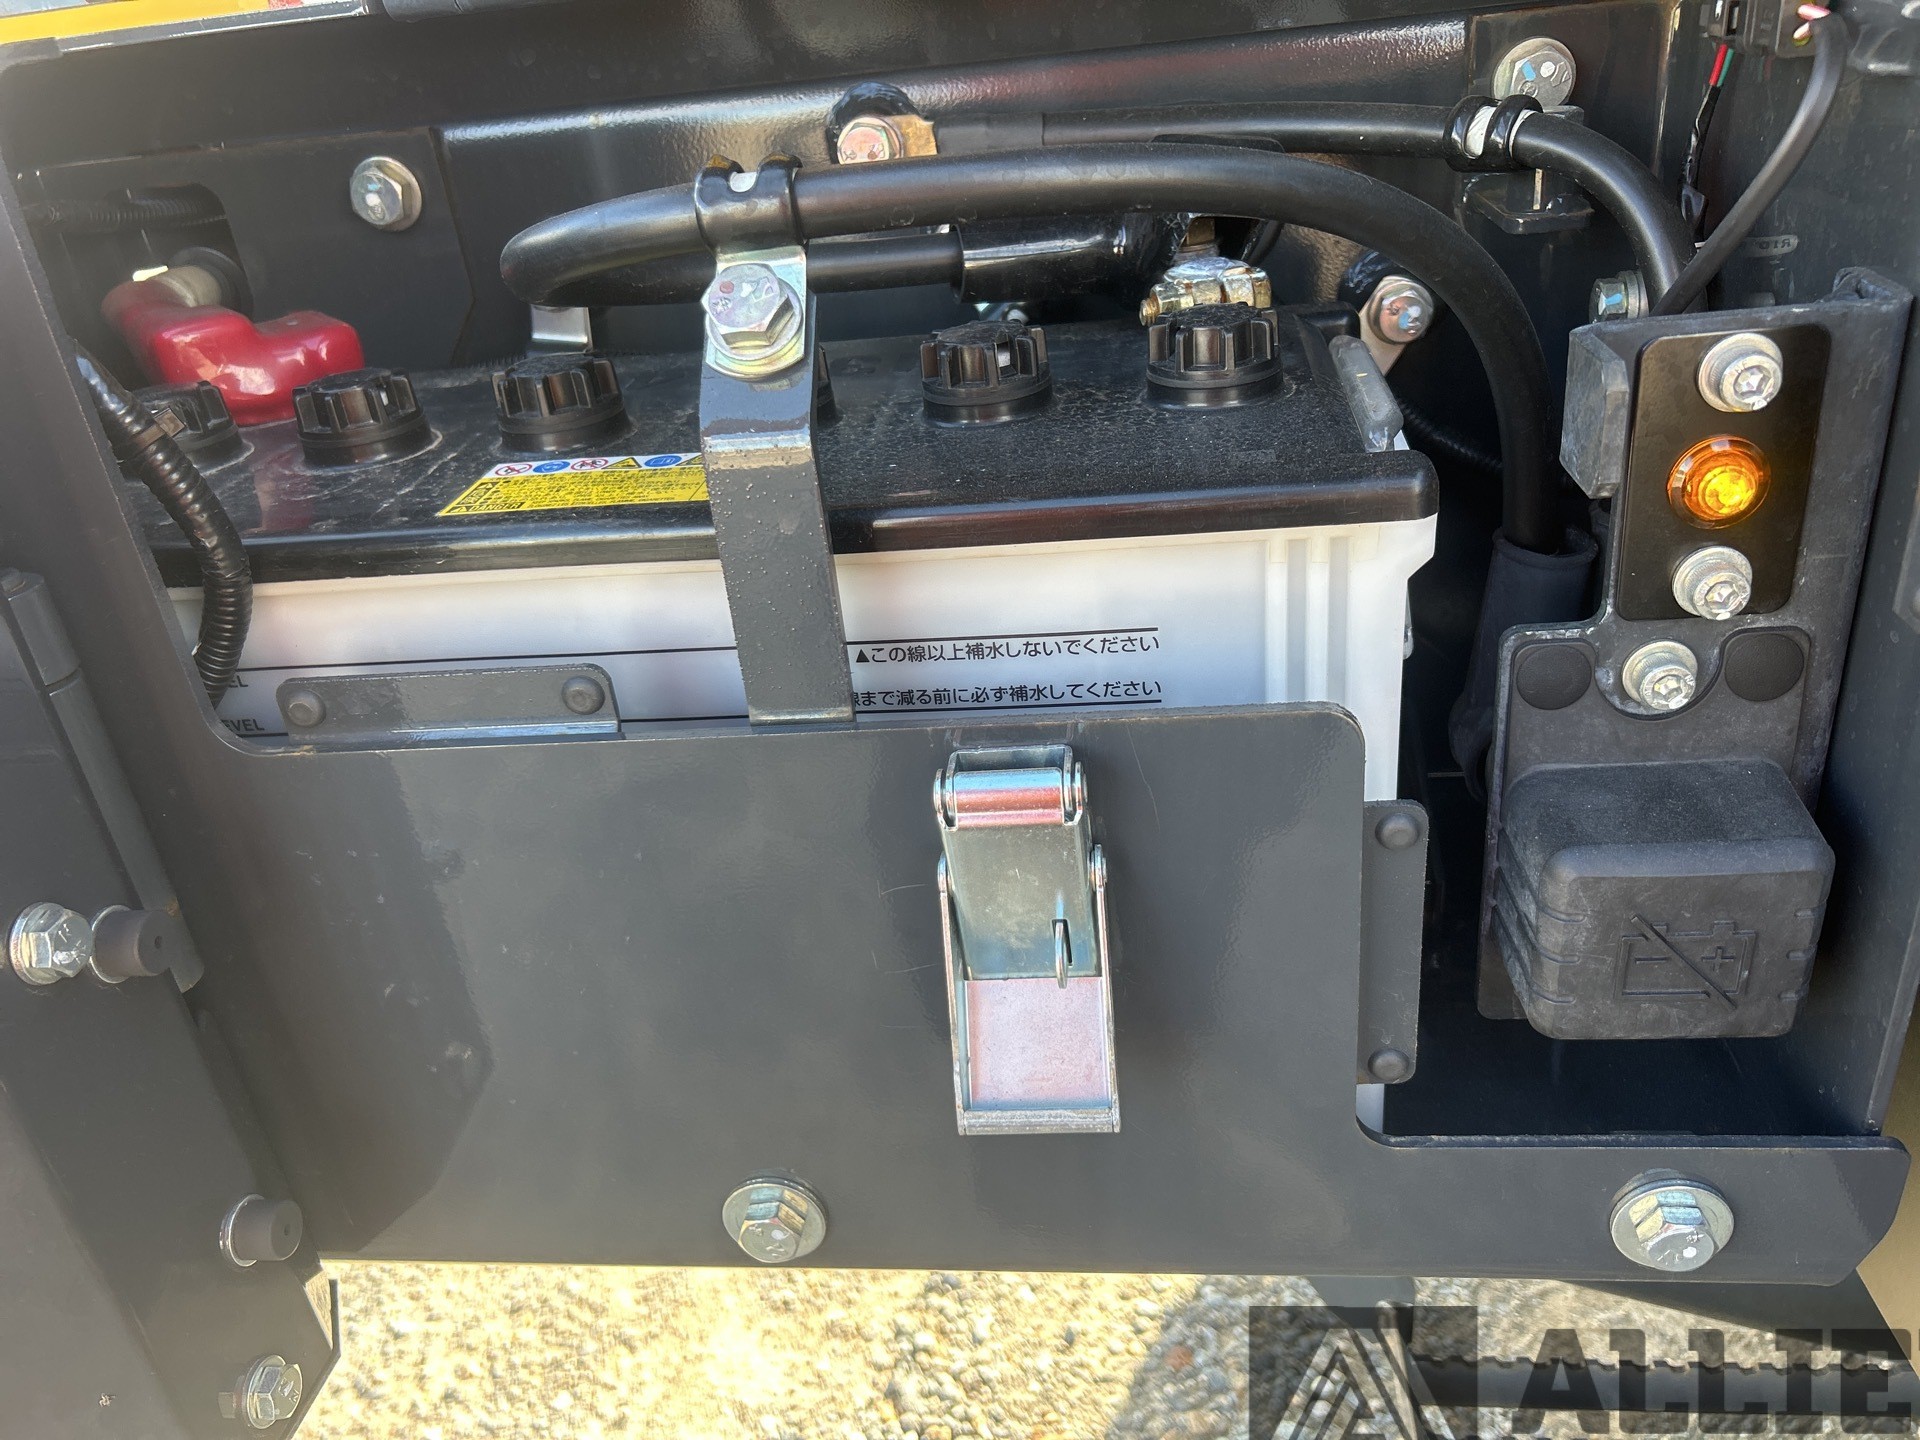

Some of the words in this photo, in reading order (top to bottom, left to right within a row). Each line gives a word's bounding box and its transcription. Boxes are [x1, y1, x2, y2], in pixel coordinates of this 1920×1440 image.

[871, 635, 1160, 663] この線以上補水しないでください
